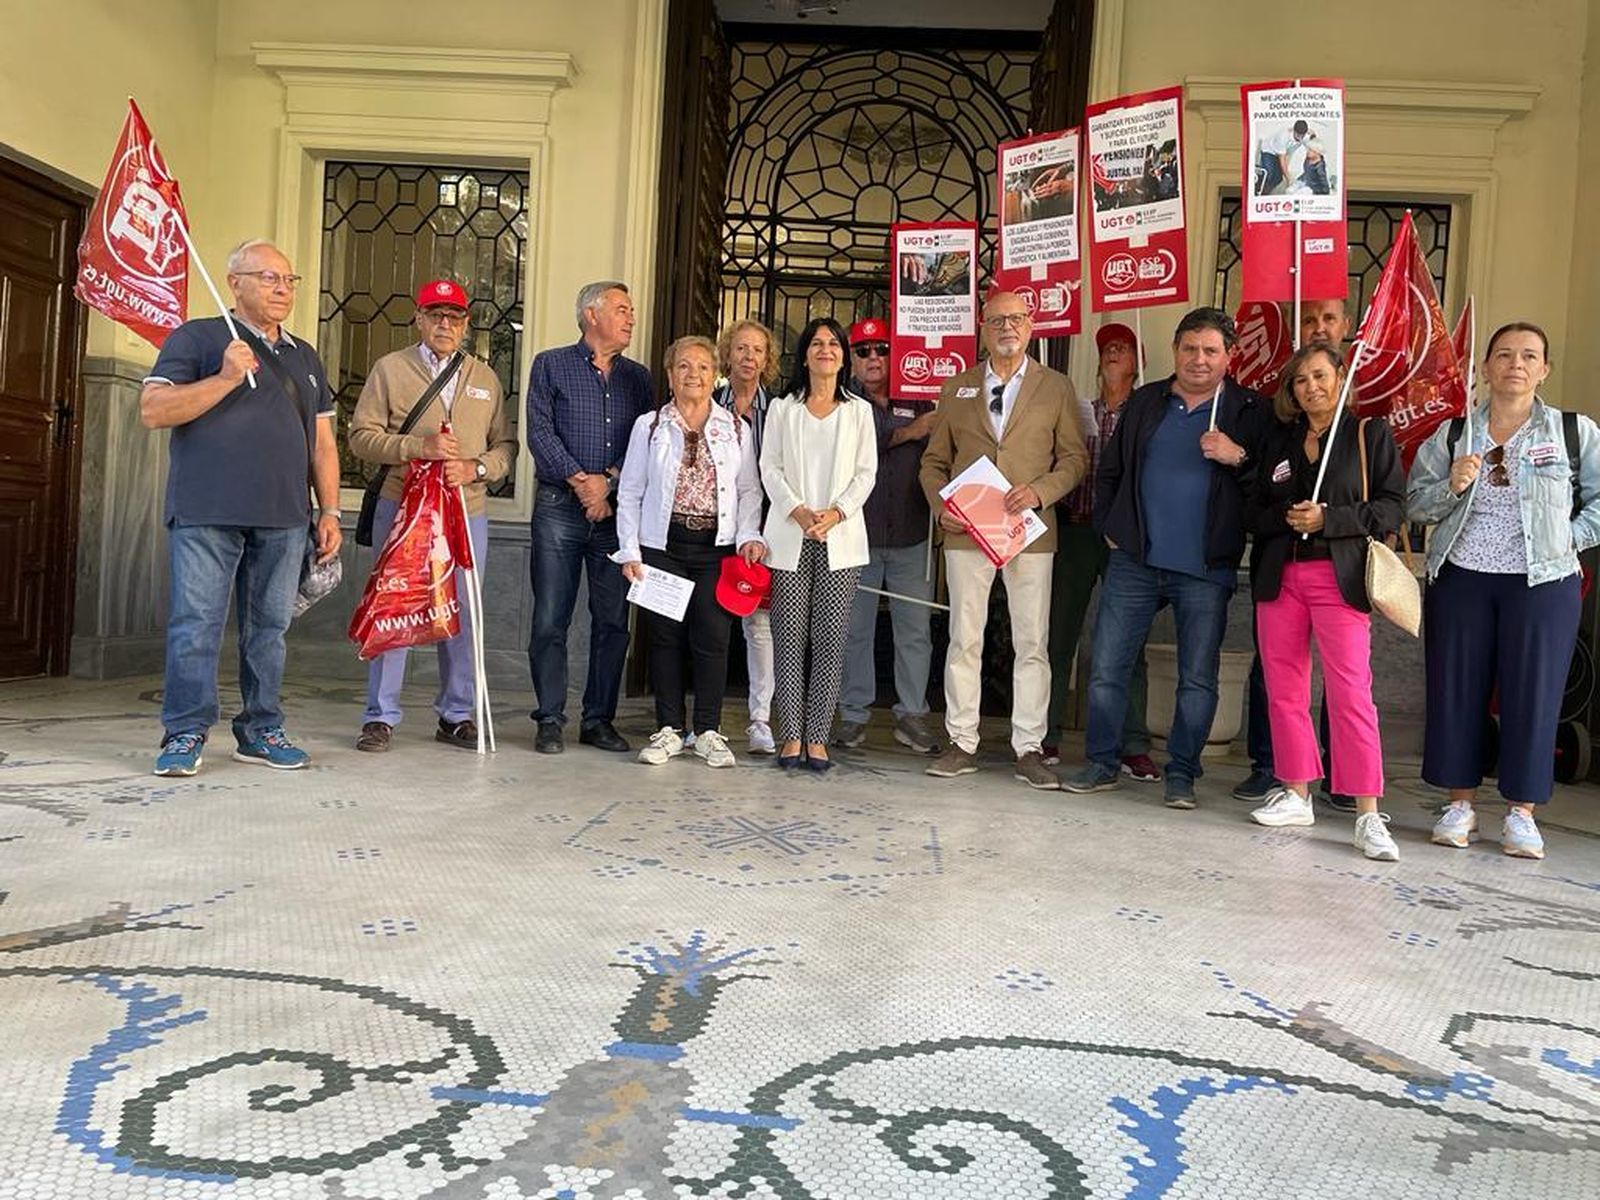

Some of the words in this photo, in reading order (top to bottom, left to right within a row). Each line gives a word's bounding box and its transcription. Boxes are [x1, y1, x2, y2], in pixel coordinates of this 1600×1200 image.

[1260, 94, 1290, 102] MEJOR
[1292, 92, 1333, 101] ATENCIÓN
[1269, 102, 1326, 110] DOMICILIARIA
[1124, 113, 1154, 124] PENSIONES
[1254, 111, 1277, 119] PARA
[1278, 110, 1340, 119] DEPENDIENTES
[1105, 126, 1138, 139] SUFICIENTES
[1138, 120, 1167, 132] ACTUALES
[1113, 138, 1128, 146] PARA
[1137, 132, 1159, 143] FUTURO
[1008, 153, 1029, 167] UGT
[1103, 147, 1145, 161] PENSIONES
[1255, 201, 1281, 213] UGT
[1100, 216, 1124, 229] UGT
[904, 236, 924, 246] UGT
[1107, 259, 1133, 275] UGT
[904, 356, 928, 369] UGT
[1007, 521, 1026, 540] UGT
